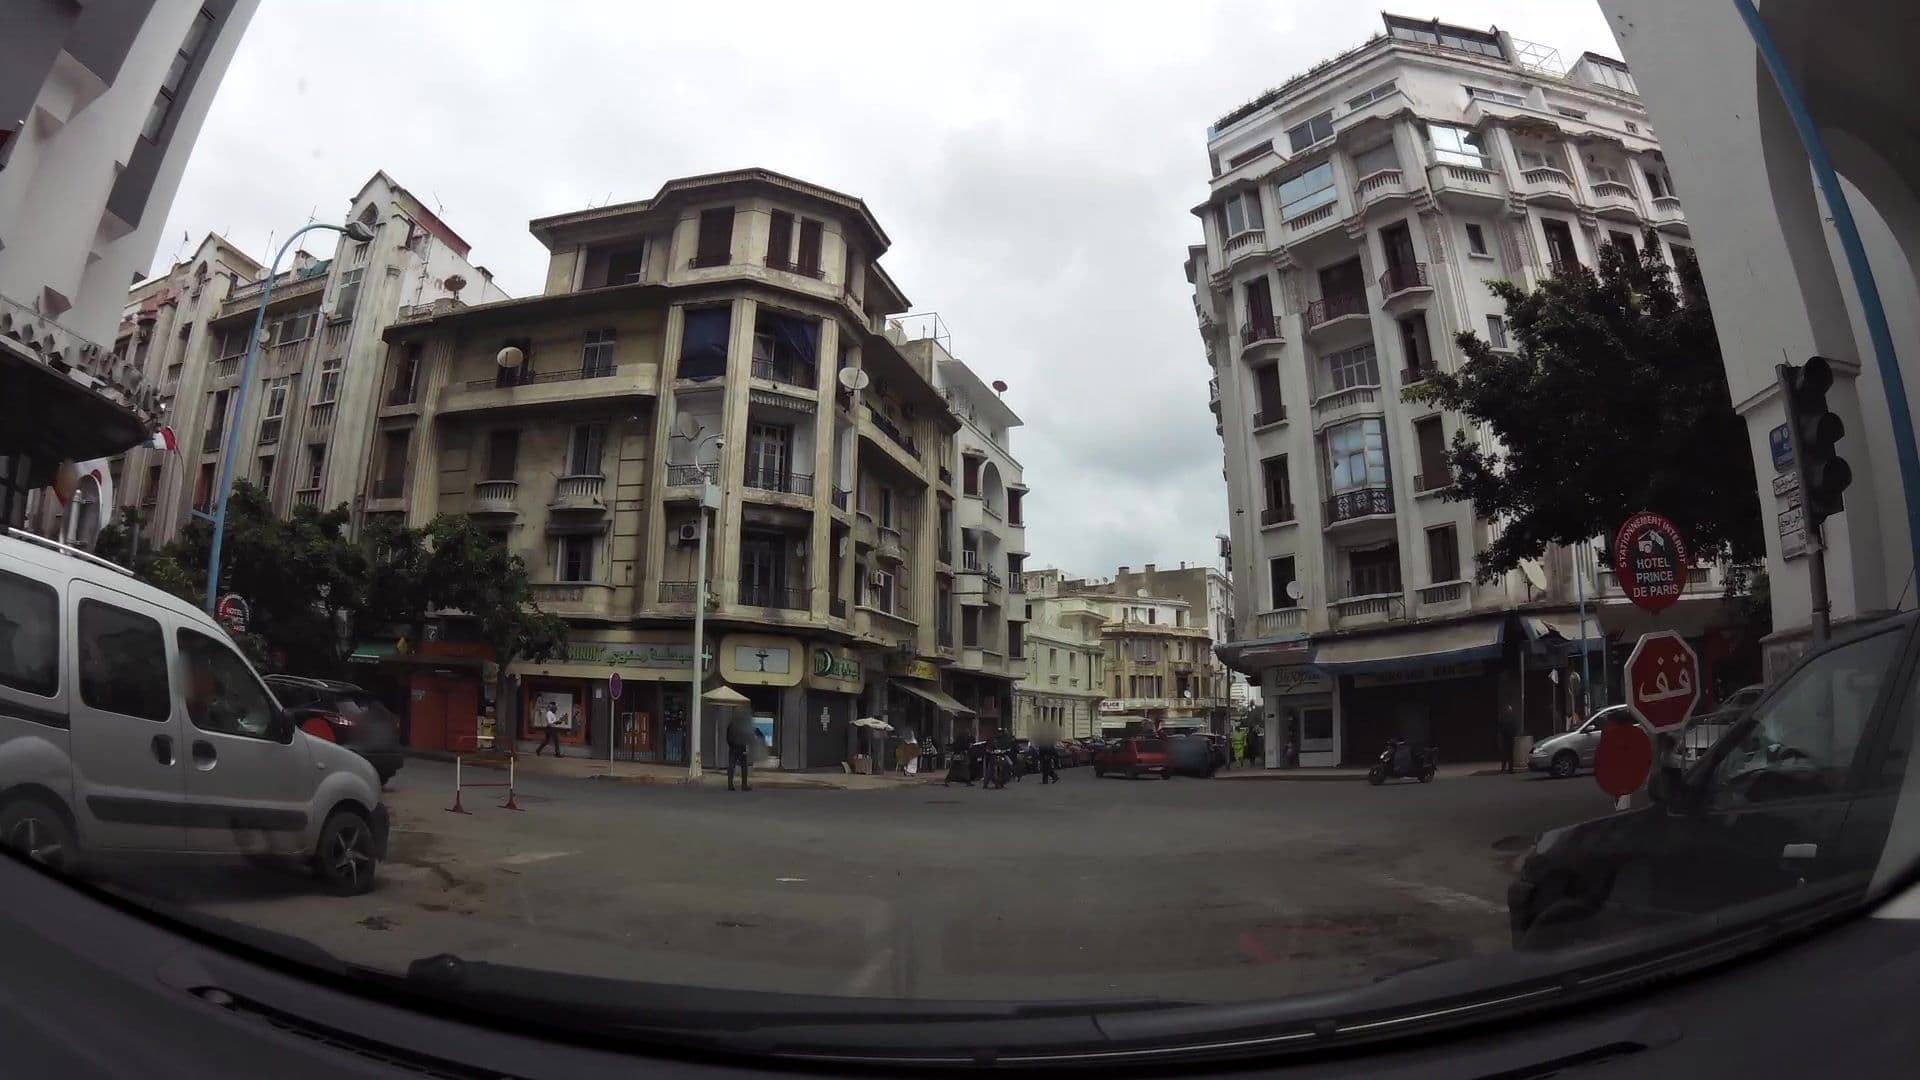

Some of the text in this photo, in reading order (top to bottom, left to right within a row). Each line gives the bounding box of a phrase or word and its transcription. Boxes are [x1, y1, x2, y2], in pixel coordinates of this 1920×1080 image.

[1619, 514, 1686, 568] STATIONNEMENT INTERDIT
[1636, 557, 1671, 569] HOTEL
[1635, 570, 1674, 584] PRINCE
[1633, 583, 1680, 598] DE PARIS
[1638, 653, 1692, 703] قف
